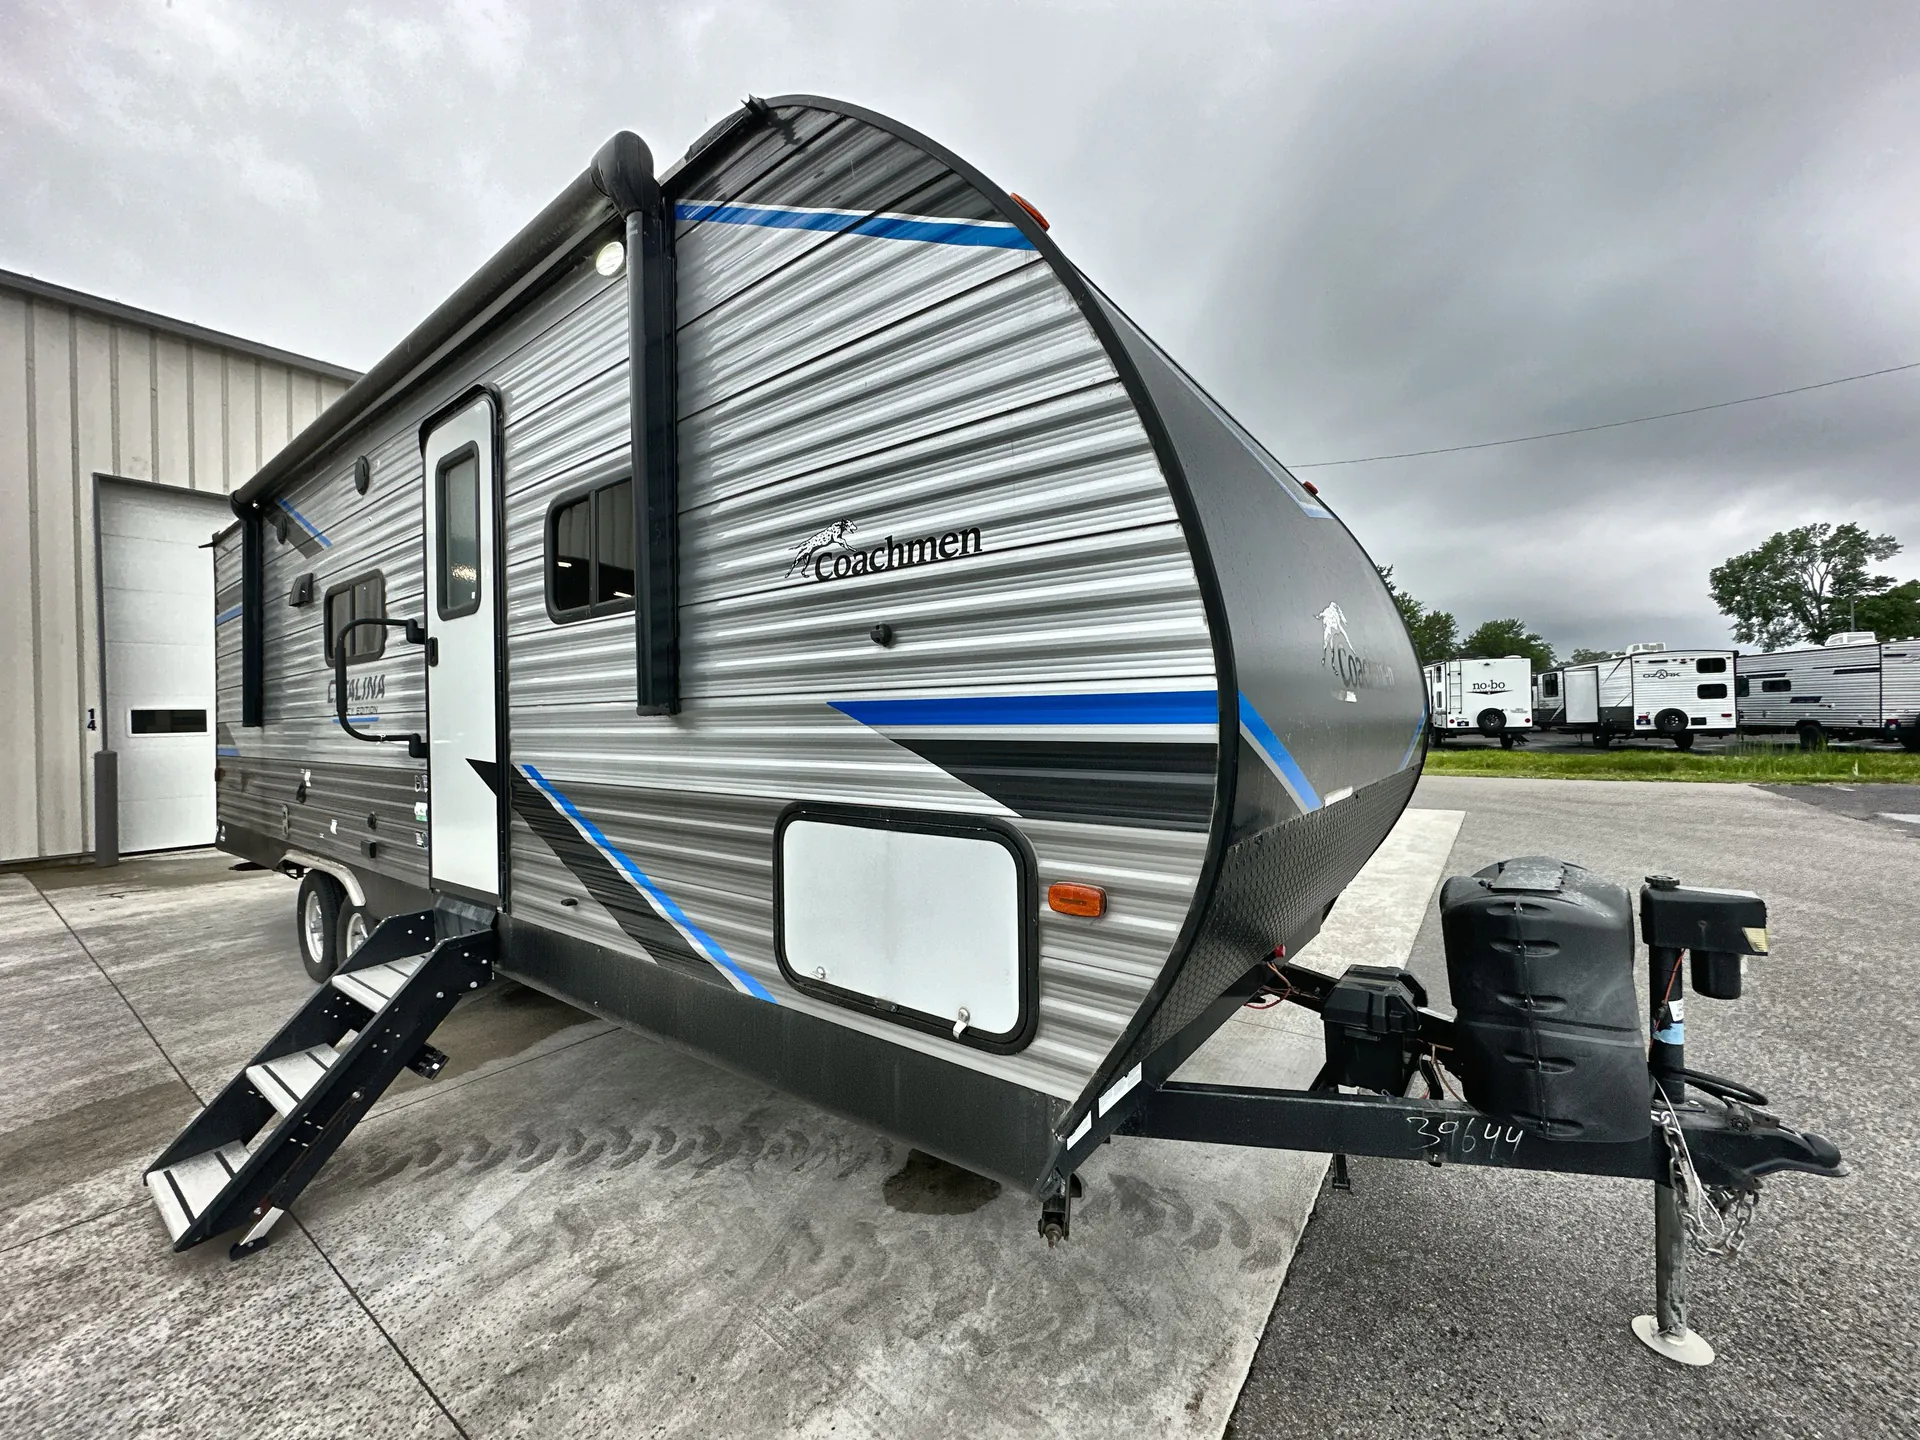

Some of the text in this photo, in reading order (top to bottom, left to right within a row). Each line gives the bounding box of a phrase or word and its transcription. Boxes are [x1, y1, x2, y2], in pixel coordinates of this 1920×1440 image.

[814, 526, 983, 581] Coachmen
[327, 674, 386, 704] CALINA
[1405, 1116, 1524, 1161] 39644
